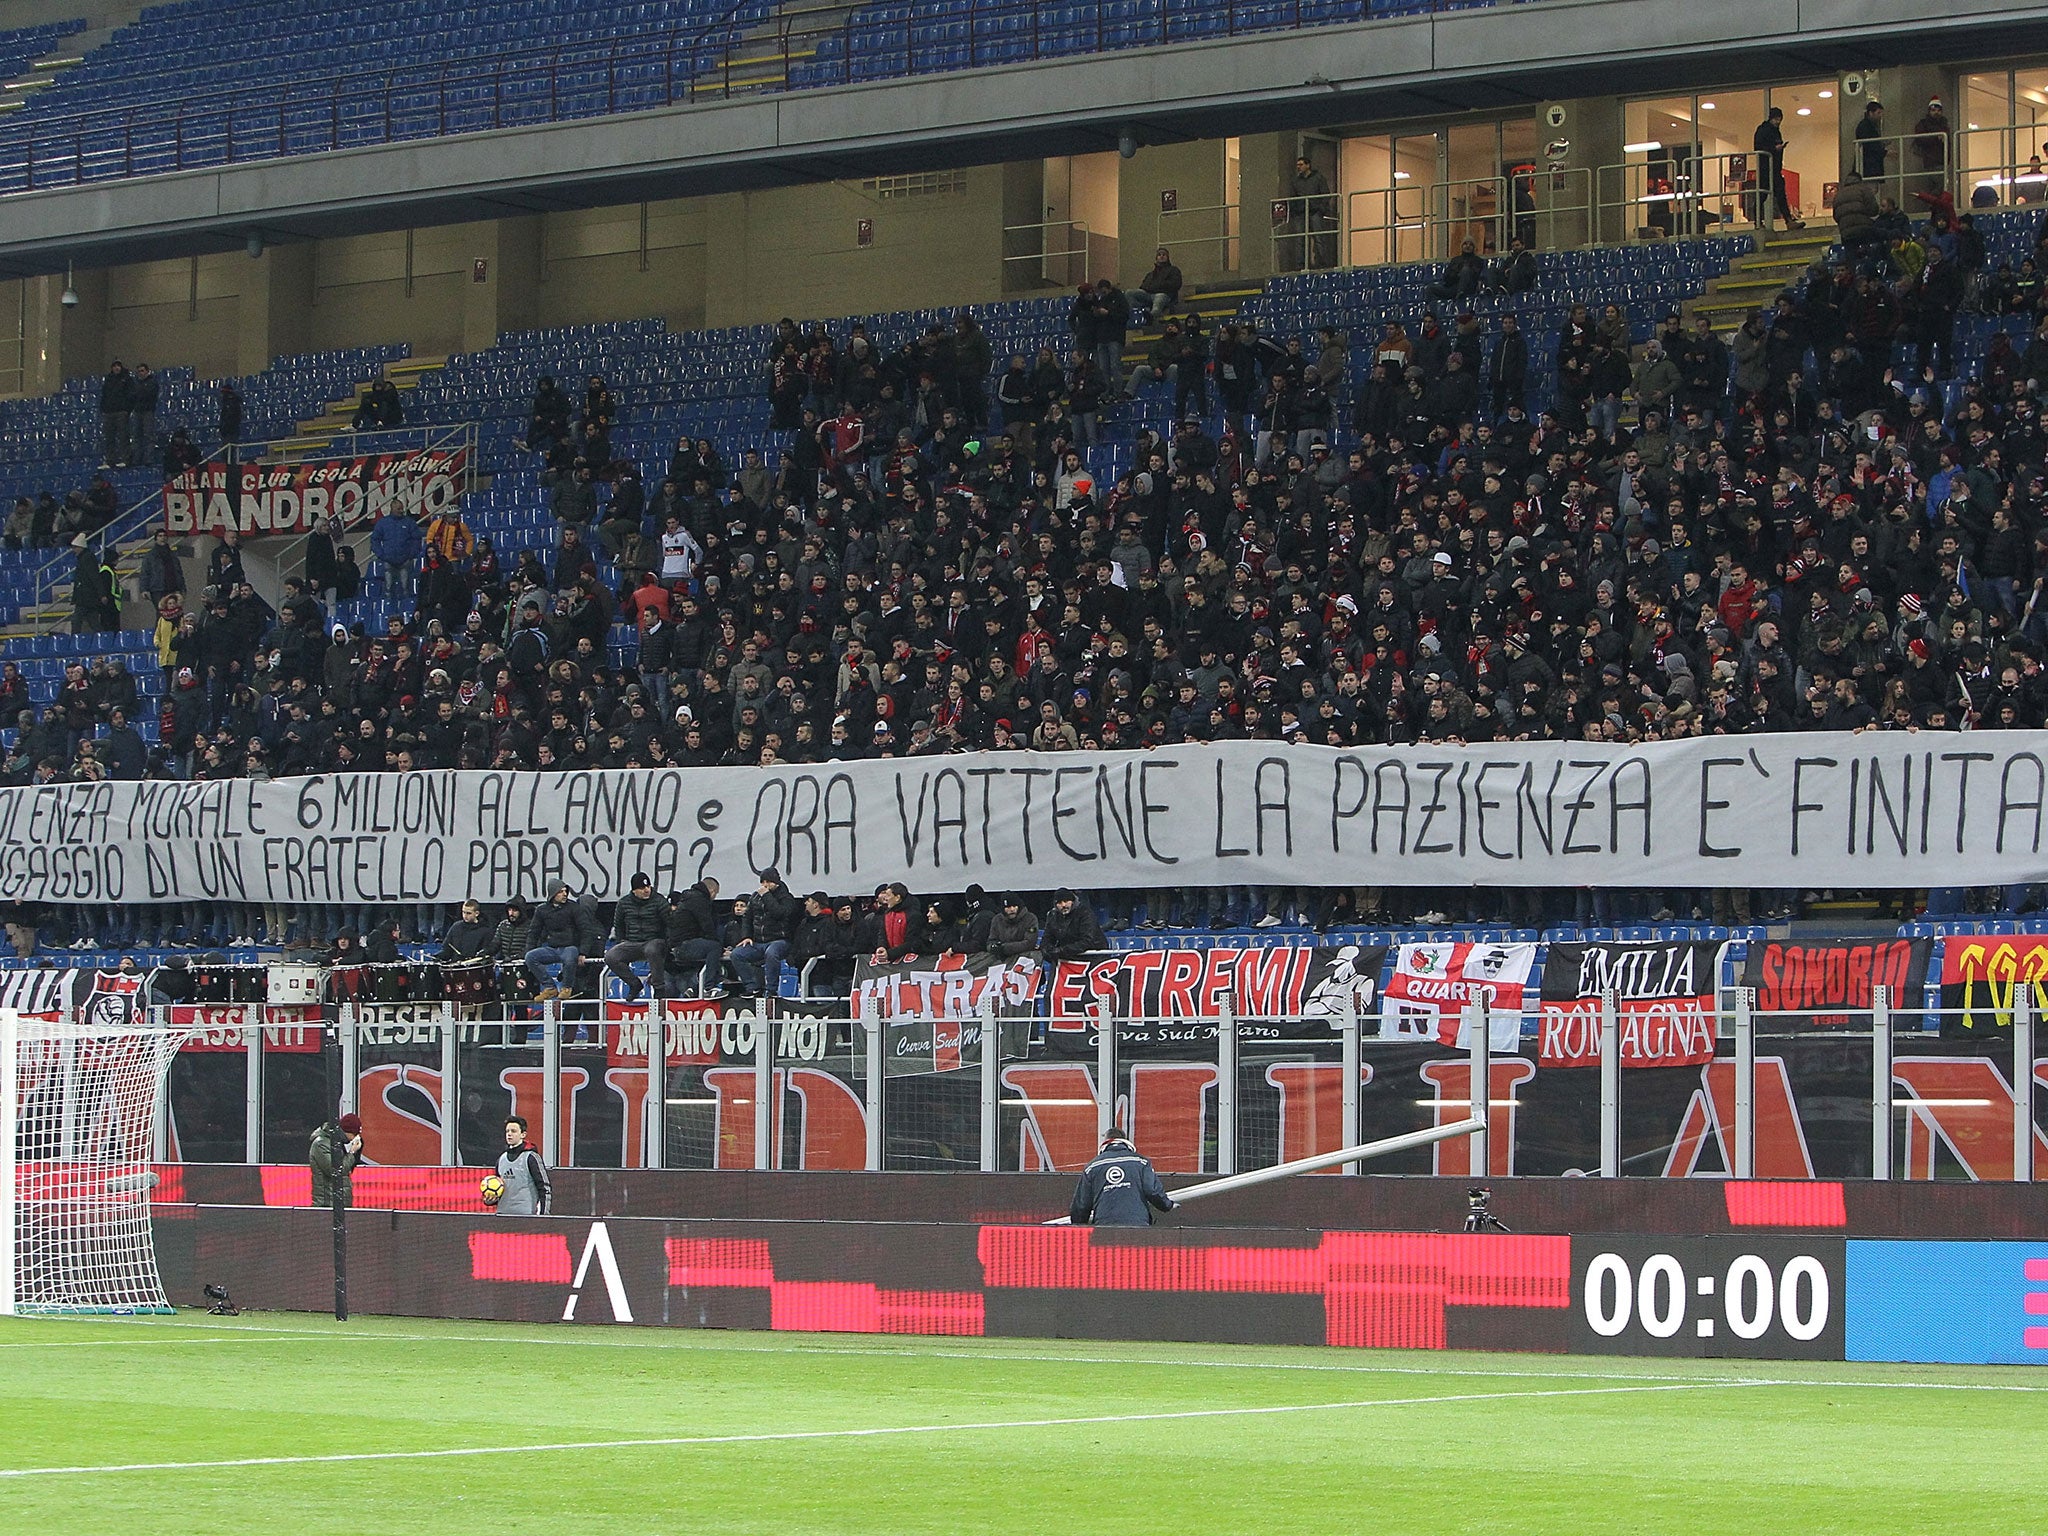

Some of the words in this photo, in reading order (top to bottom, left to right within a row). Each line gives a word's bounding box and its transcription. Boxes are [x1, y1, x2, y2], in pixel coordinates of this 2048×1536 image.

[166, 474, 455, 532] BIANDRONNO
[173, 472, 226, 490] MILAN
[242, 472, 291, 491] CLUB
[308, 465, 362, 484] ISOLA
[379, 456, 453, 476] VIRGINIA
[127, 778, 266, 841] MORALE
[299, 775, 323, 830] 6
[331, 771, 456, 838] MILIONI
[478, 771, 682, 838] ALL'ANNO
[697, 799, 724, 831] e
[746, 773, 858, 876] ORA
[896, 760, 1180, 867] VATTENE
[1215, 757, 1292, 858] LA
[1331, 755, 1651, 860] PAZIENZA
[1790, 751, 2046, 857] FINITA
[146, 844, 179, 899] DI
[197, 842, 248, 901] UN
[263, 837, 444, 901] FRATELLO
[467, 837, 714, 898] PARASSITA?
[860, 956, 1036, 1028] ULTRAS
[1048, 946, 1313, 1034] ESTREMI
[1406, 980, 1498, 1003] QUARTO
[1576, 946, 1696, 999] EMILIA
[1759, 940, 1912, 1014] SONDRIO
[777, 1010, 829, 1062] NOI
[896, 1035, 931, 1057] Curva
[935, 1032, 960, 1050] Sud
[1157, 1024, 1201, 1042] Sud
[1583, 1252, 1831, 1341] 00:00
